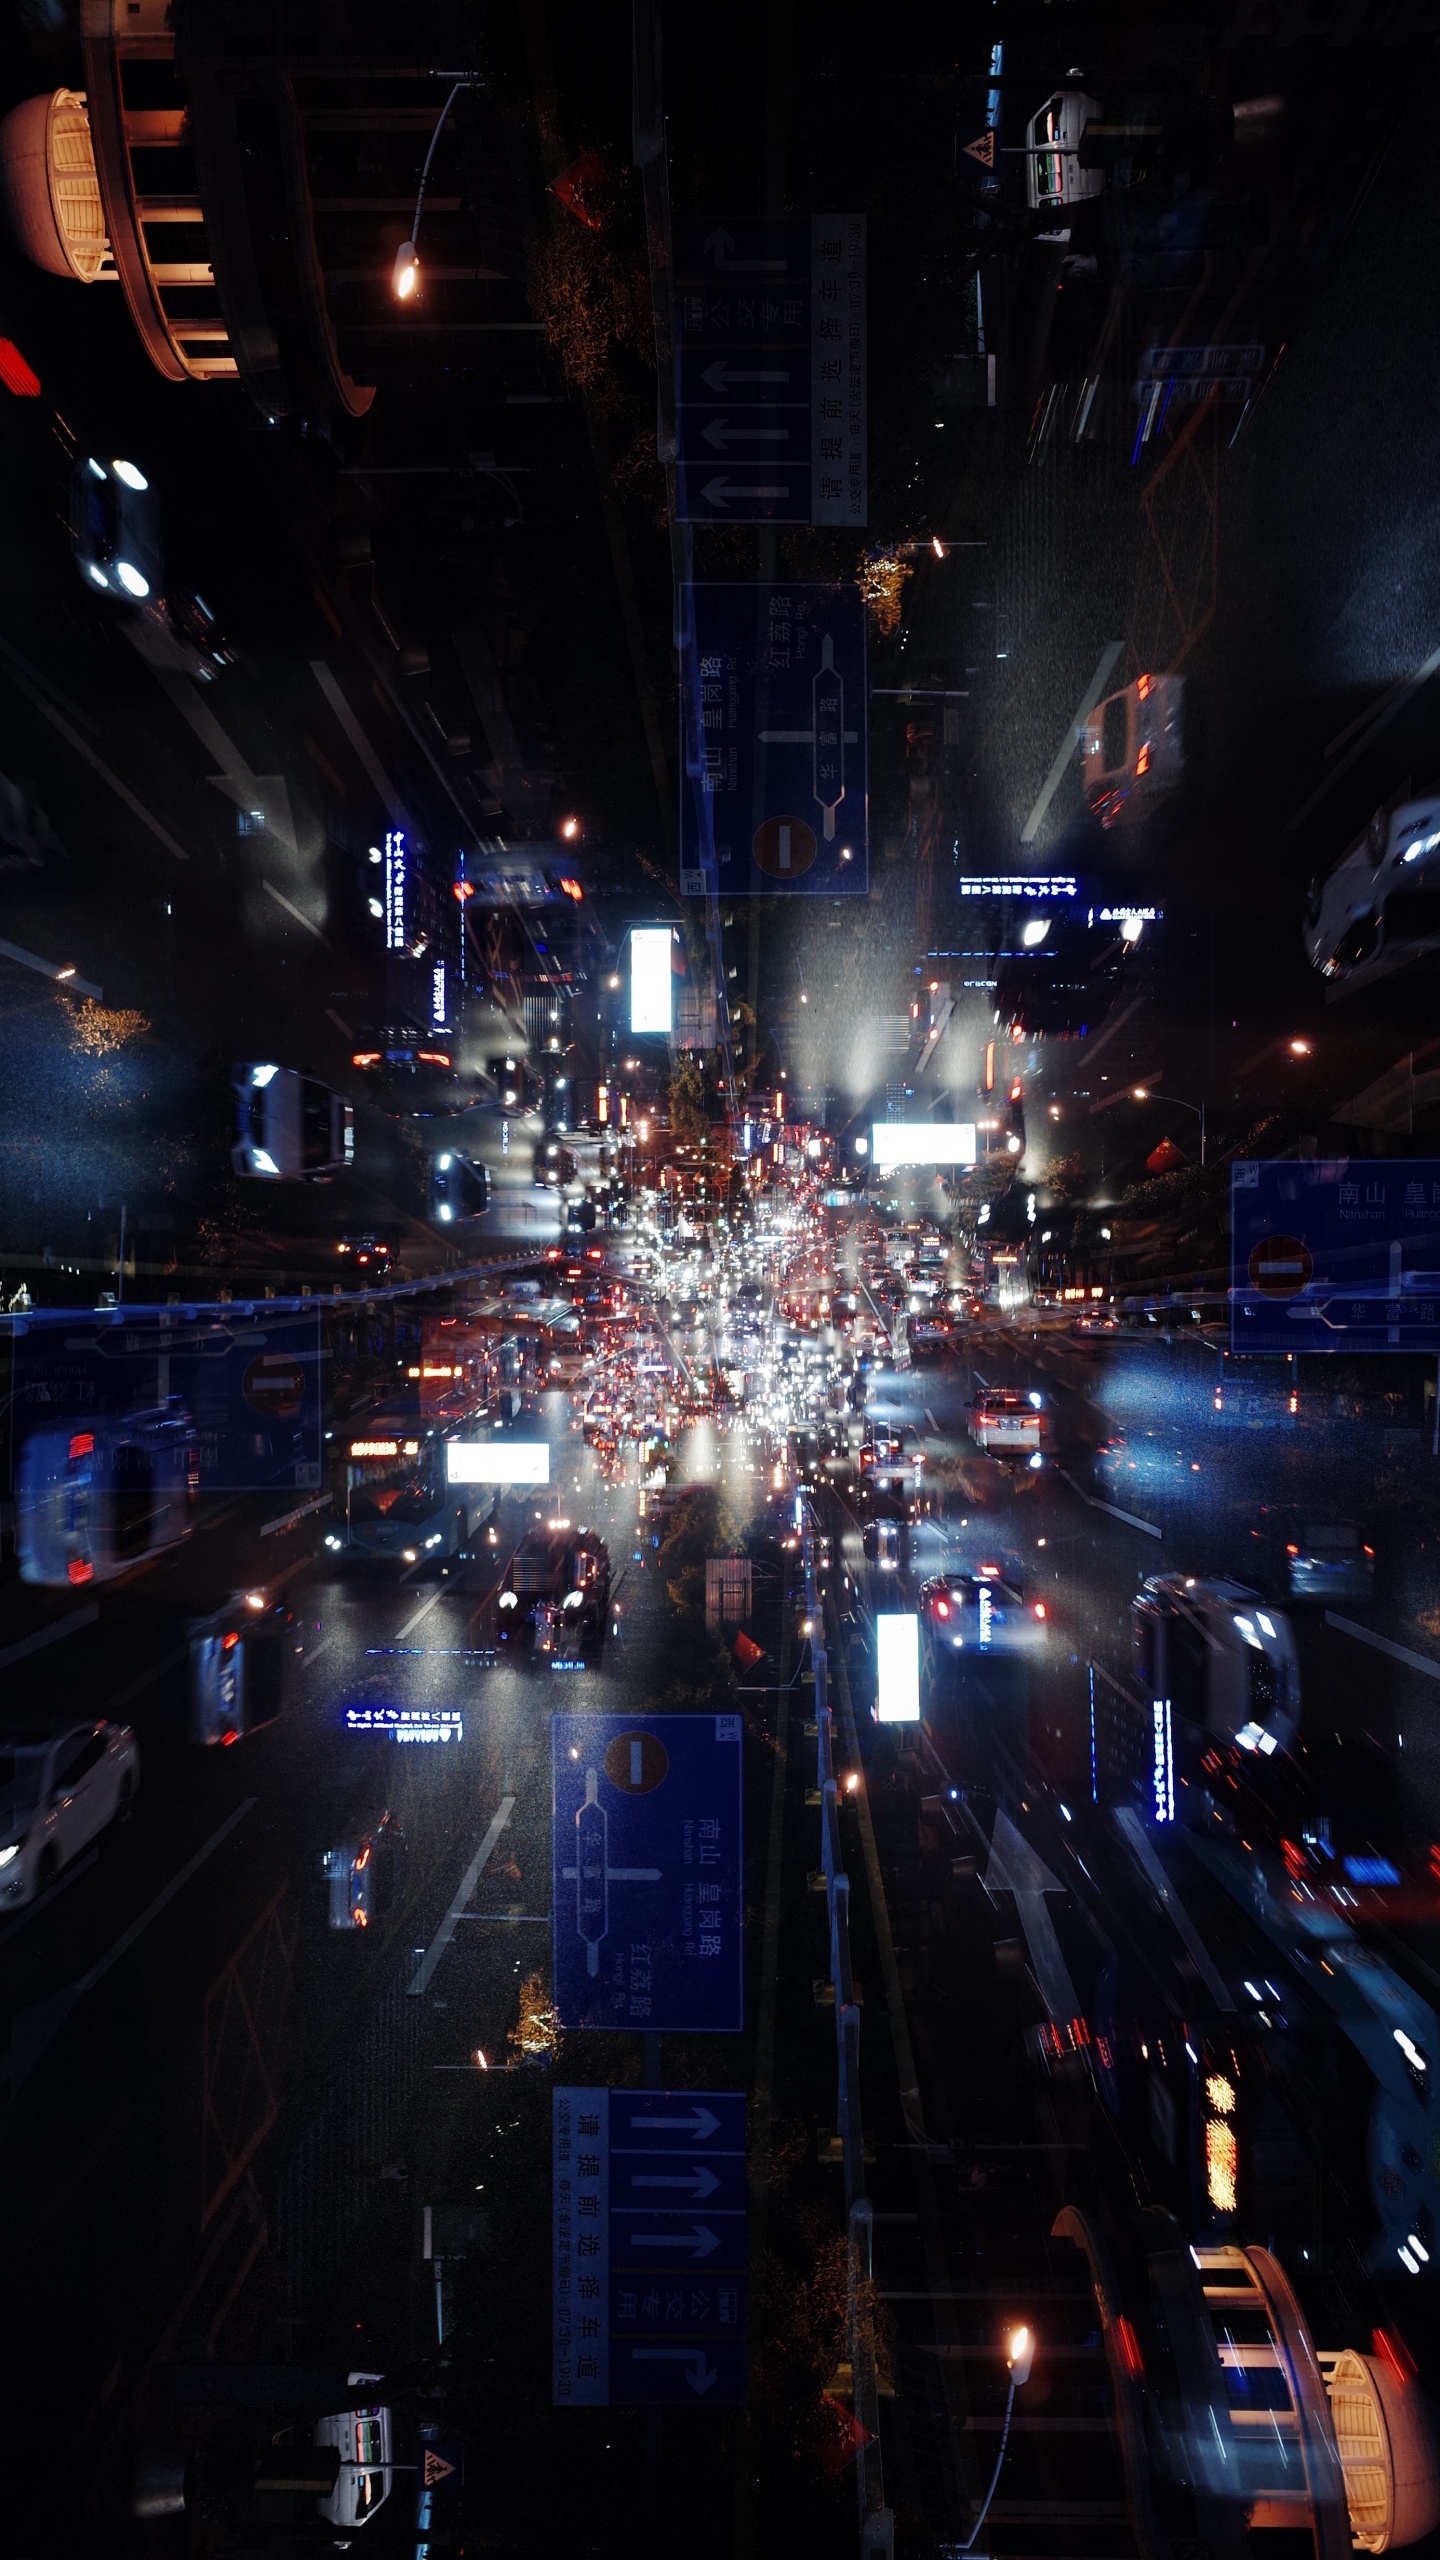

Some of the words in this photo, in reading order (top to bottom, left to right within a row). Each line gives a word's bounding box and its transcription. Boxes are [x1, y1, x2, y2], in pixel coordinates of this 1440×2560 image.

[711, 298, 803, 330] 公交专用
[819, 240, 842, 500] 请提前选择车道
[768, 595, 791, 668] 红荔路
[795, 626, 808, 659] Hongli
[727, 657, 737, 670] Rd
[700, 656, 722, 729] 皇岗路
[727, 676, 739, 728] Huanggang
[819, 697, 838, 779] 华富路
[700, 747, 723, 792] 南山
[727, 747, 737, 791] Nanshan
[684, 870, 693, 878] W
[687, 882, 701, 893] 西
[1234, 1168, 1246, 1183] 西
[1250, 1164, 1258, 1175] W
[1338, 1181, 1386, 1205] 南山
[1339, 1208, 1386, 1220] Nanshan
[1351, 1302, 1436, 1323] 华富路
[720, 1717, 735, 1728] 西
[729, 1732, 737, 1740] W
[684, 1820, 694, 1864] Nanshan
[698, 1819, 721, 1864] 南山
[681, 1883, 694, 1936] Huanggang
[698, 1882, 722, 1956] 皇岗路
[684, 1942, 695, 1955] Rd
[613, 1953, 626, 1986] Hongli
[630, 1943, 653, 2018] 红荔路
[578, 2113, 601, 2379] 请提前选择车道
[616, 2288, 710, 2320] 公交专用
